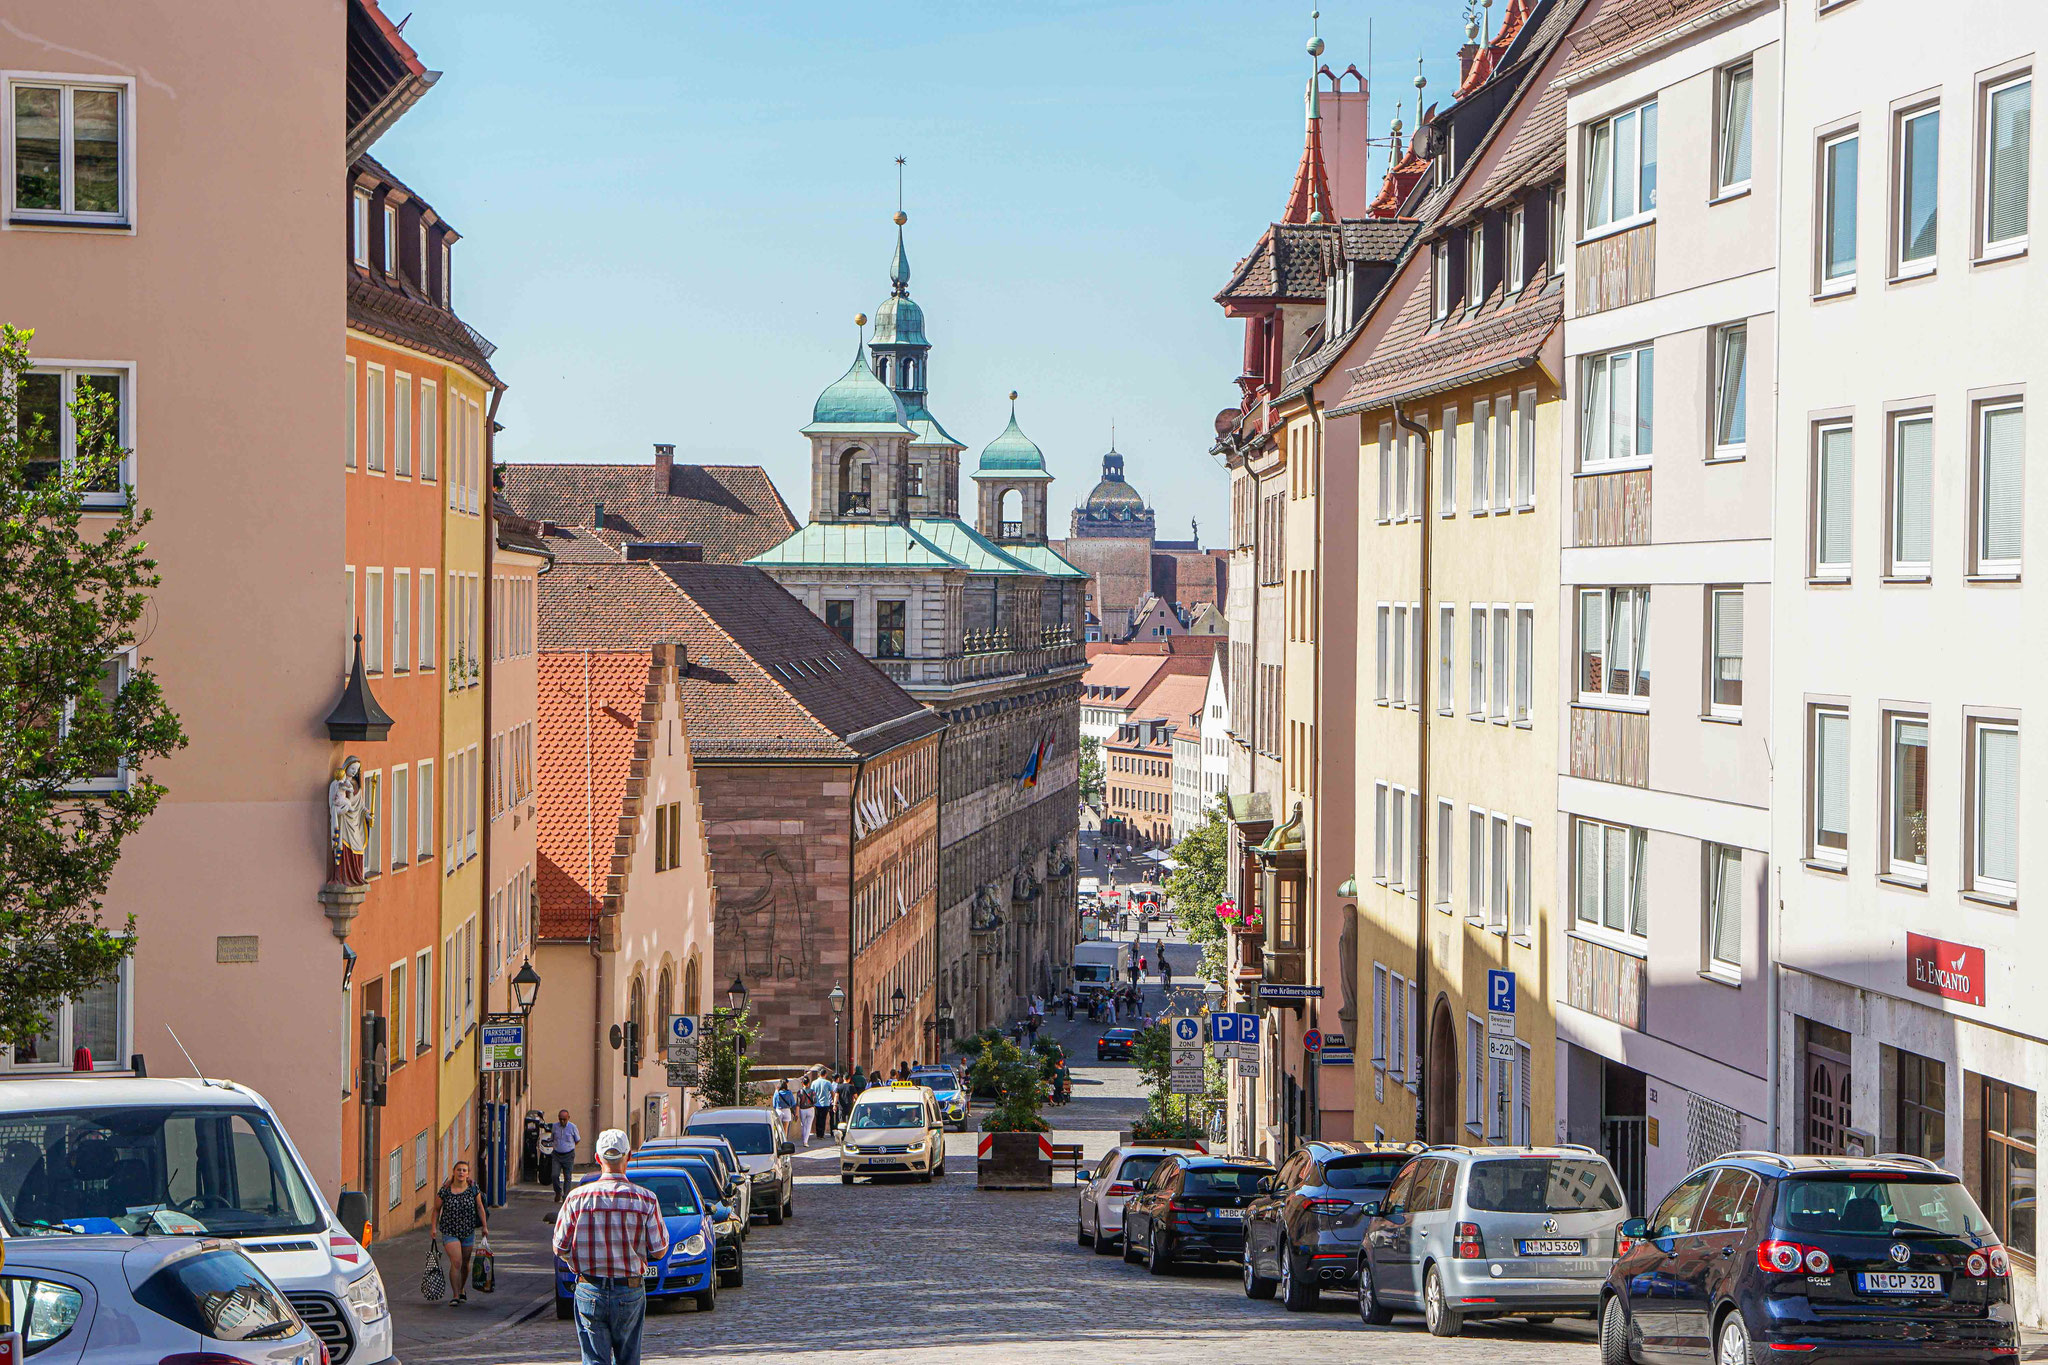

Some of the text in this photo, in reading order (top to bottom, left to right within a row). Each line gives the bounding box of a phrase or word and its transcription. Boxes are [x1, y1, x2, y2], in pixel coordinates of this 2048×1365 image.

[1260, 986, 1321, 996] Obere Krämersgasse
[1494, 975, 1510, 1006] P
[1217, 1016, 1233, 1039] P
[1242, 1017, 1254, 1040] P
[485, 1029, 520, 1037] PARKSCHEIN-
[490, 1036, 515, 1044] AUTOMAT
[1326, 1036, 1343, 1044] Obere
[1490, 1041, 1514, 1057] 8-22h
[1239, 1064, 1258, 1074] 8-22h
[1526, 1241, 1579, 1252] N MJ 5369
[1807, 1275, 1831, 1283] GOLF
[1870, 1274, 1936, 1289] N CP 328
